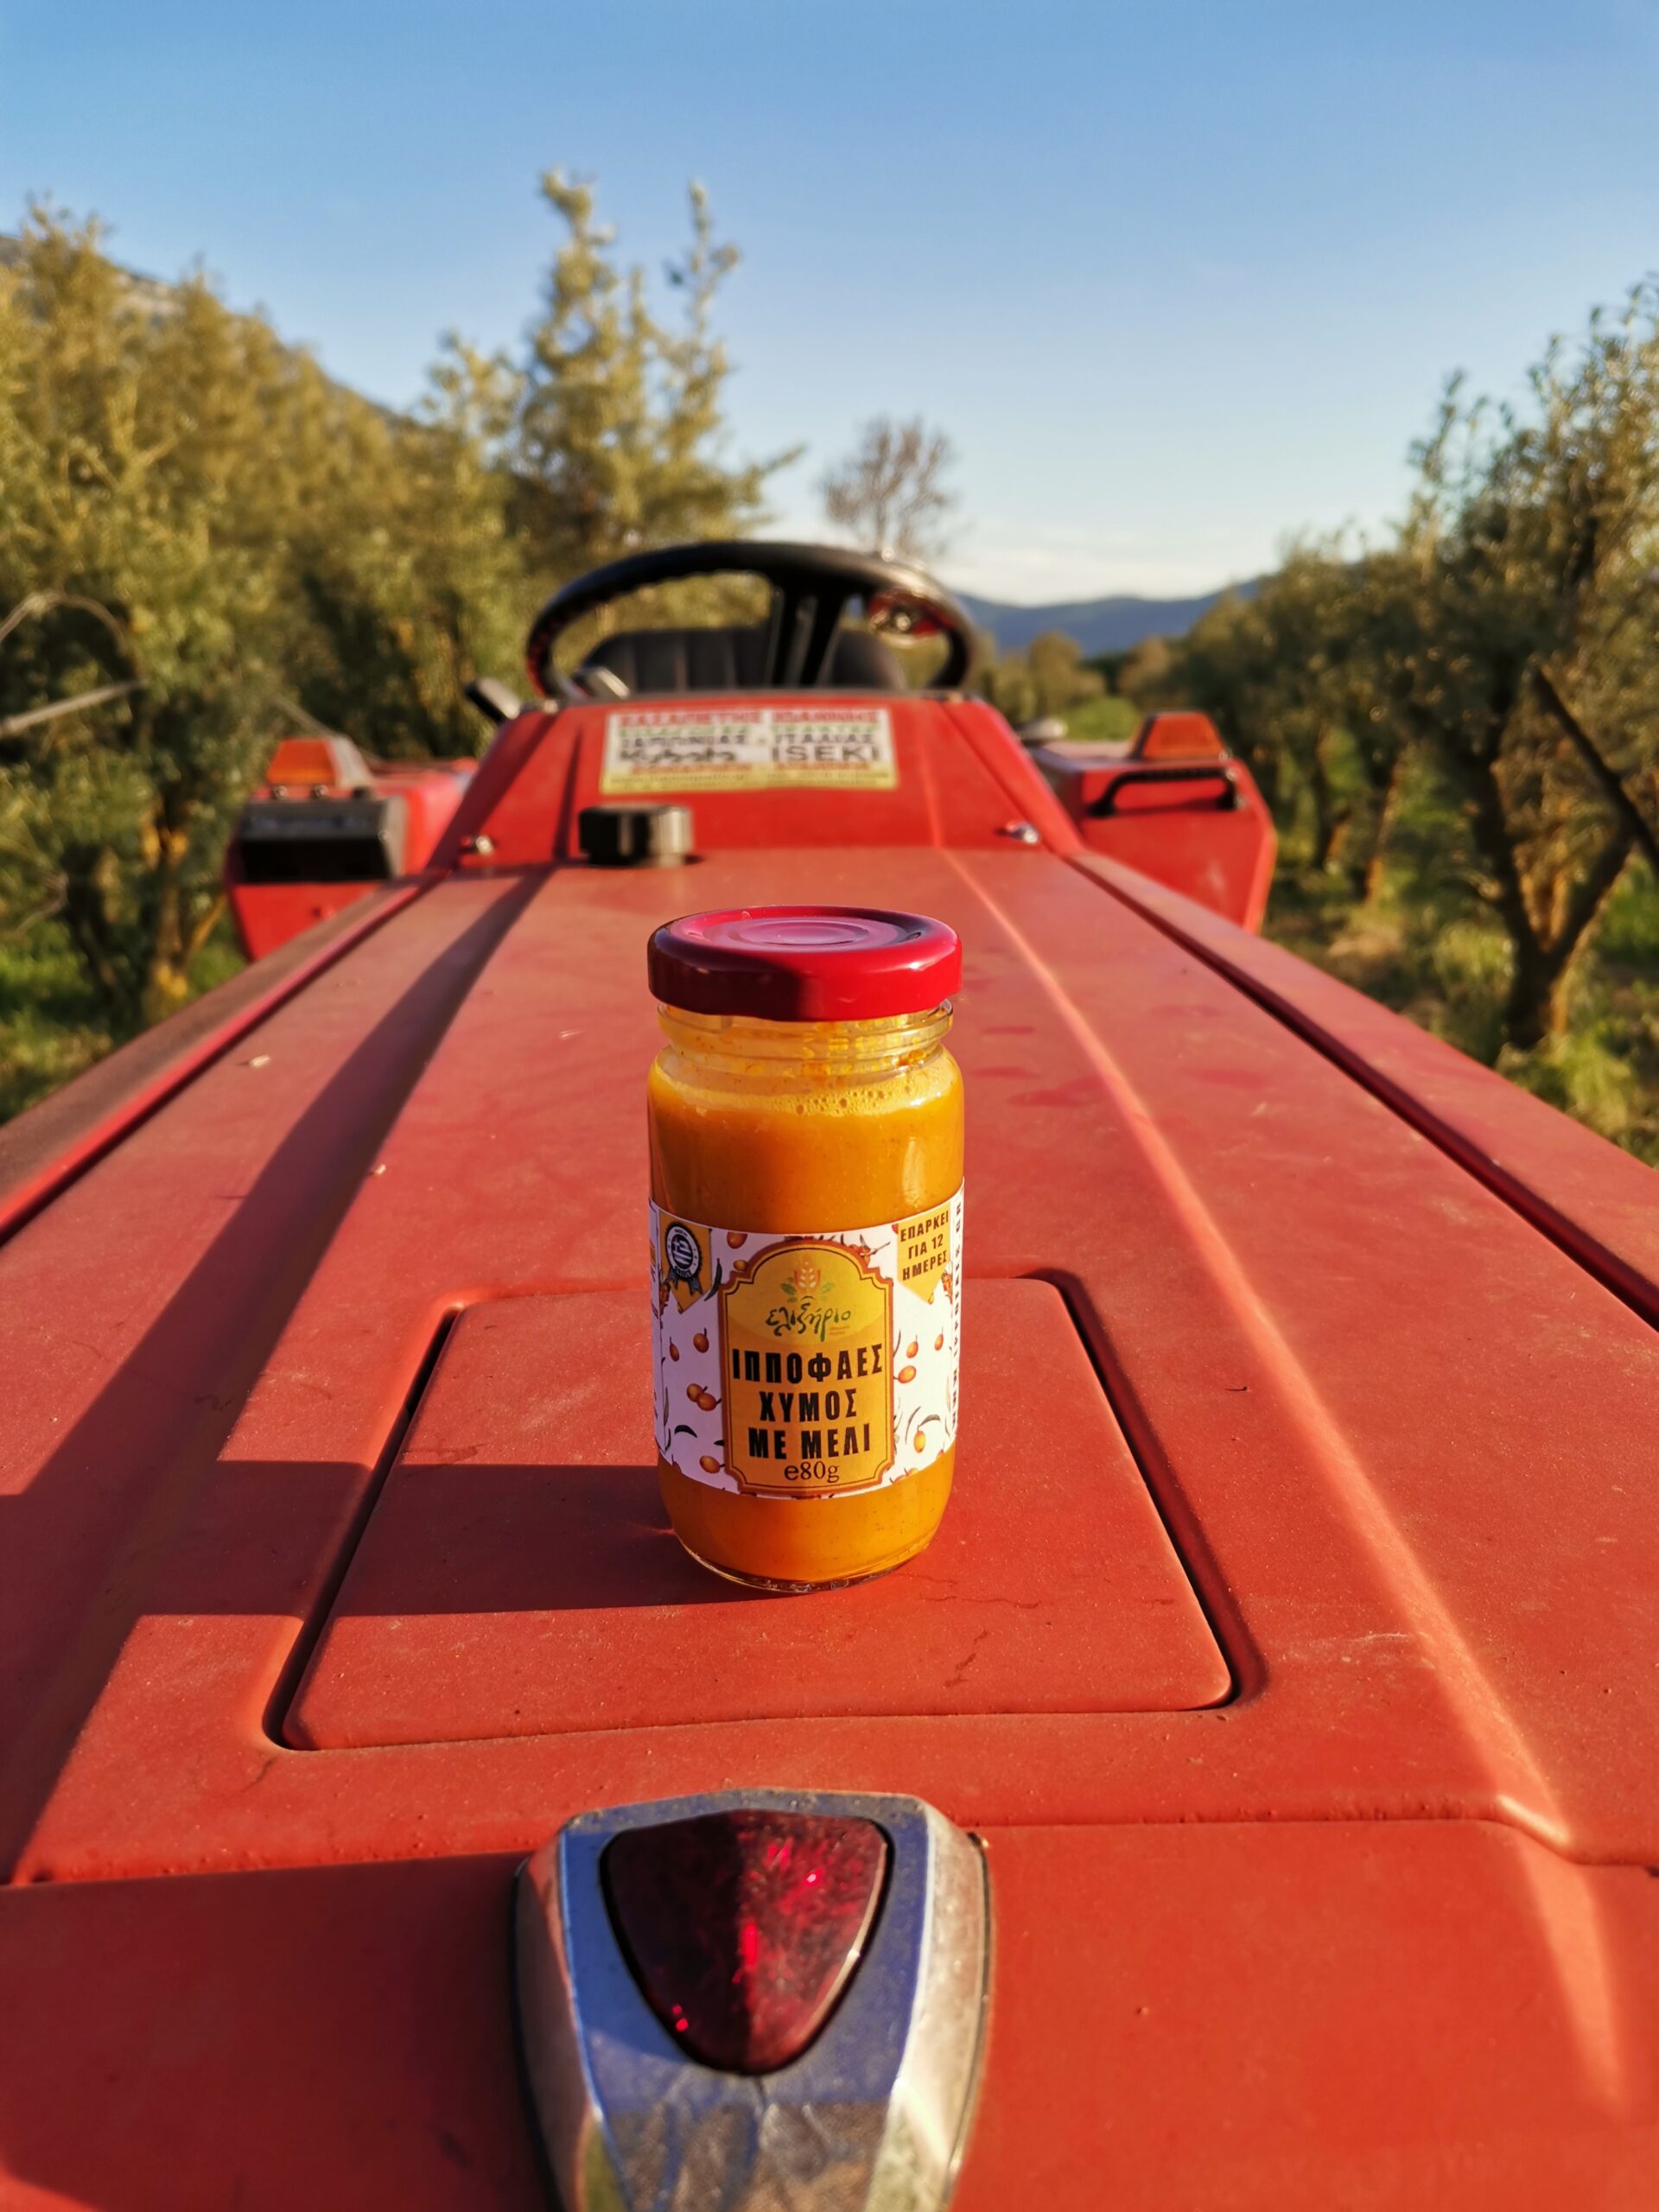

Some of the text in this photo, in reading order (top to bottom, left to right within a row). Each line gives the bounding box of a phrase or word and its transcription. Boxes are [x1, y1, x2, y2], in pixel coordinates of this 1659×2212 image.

[772, 745, 880, 761] ISEKI
[899, 1211, 949, 1242] ΕΠΑΡΚΕΙ
[908, 1234, 944, 1259] ΓΙΑ 12
[902, 1249, 947, 1281] ΗΜΕΡΕΣ
[732, 1343, 882, 1384] ΙΠΠΟΦΑΕΣ
[759, 1388, 857, 1423] ΧΥΜΟΣ
[748, 1423, 870, 1459] ΜΕ ΜΕΛΙ
